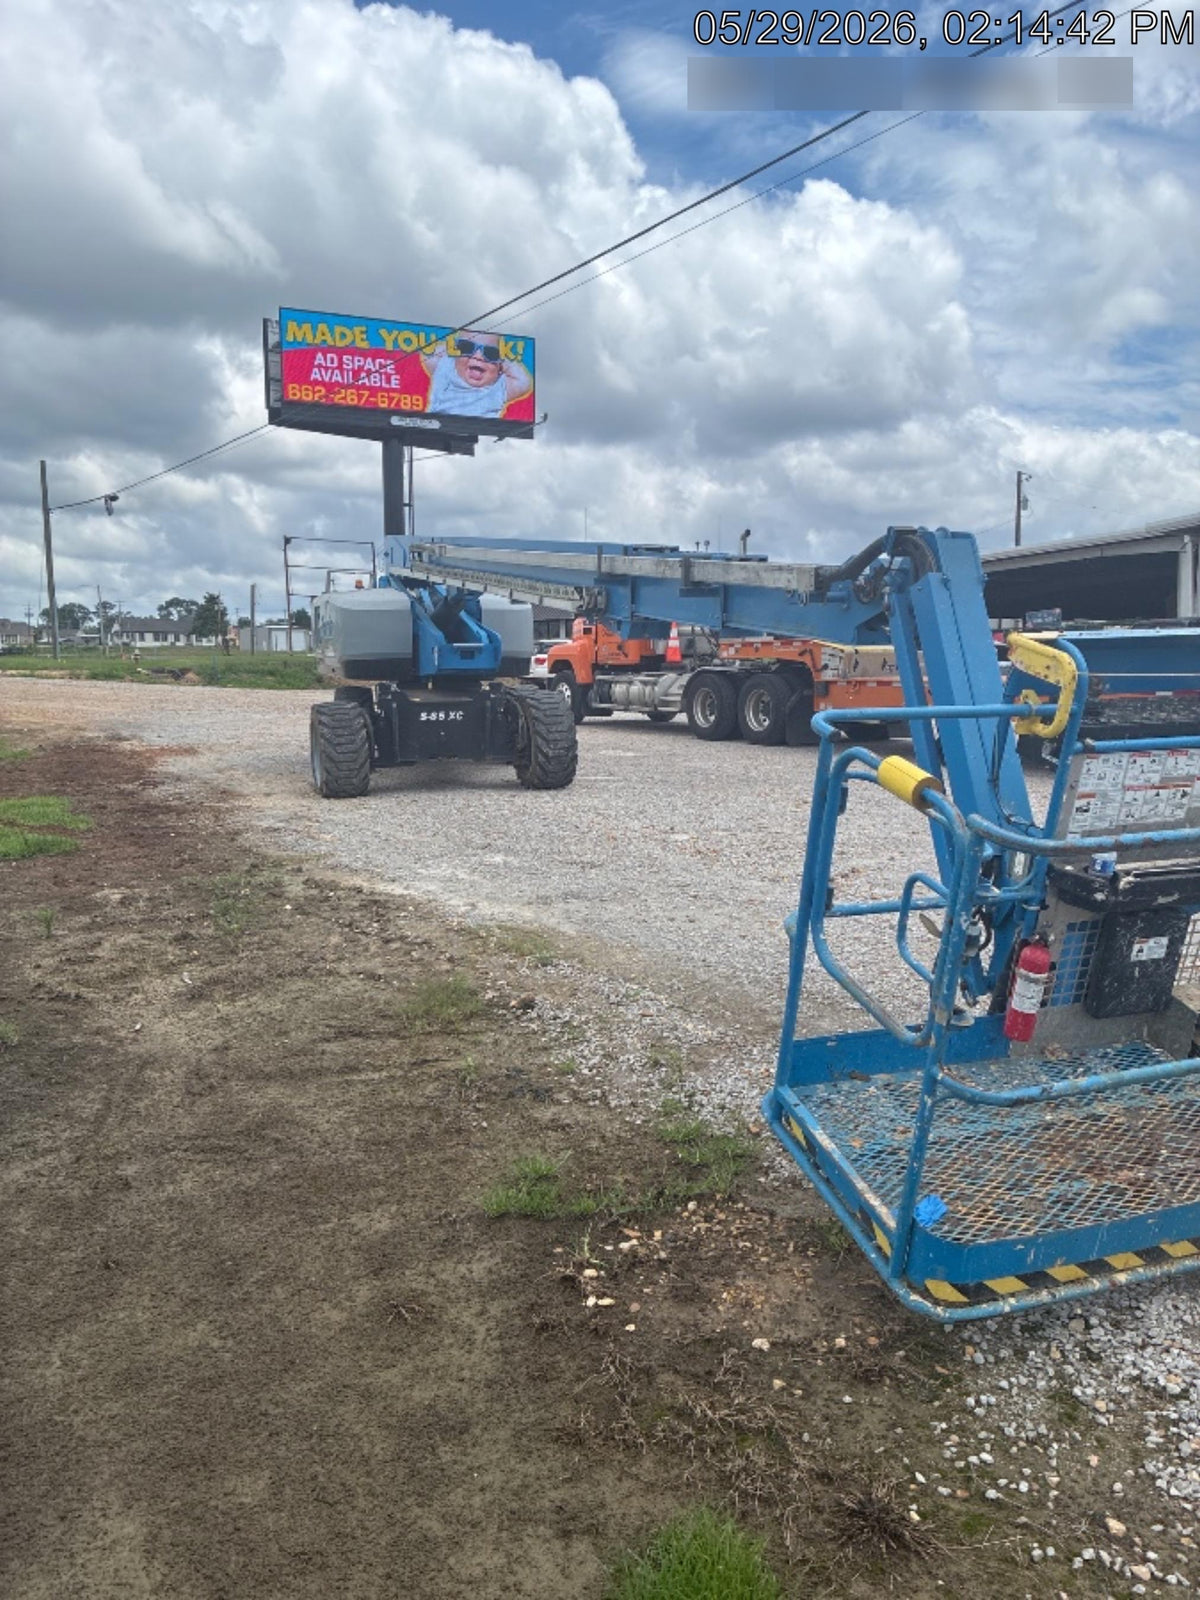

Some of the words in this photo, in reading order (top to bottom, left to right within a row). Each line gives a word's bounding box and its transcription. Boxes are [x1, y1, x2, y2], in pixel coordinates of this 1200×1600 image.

[286, 320, 370, 349] MADE
[378, 328, 437, 355] YOU
[446, 333, 525, 361] LK!
[314, 352, 338, 367] AD
[342, 355, 396, 374] SPACE
[311, 367, 400, 388] AVAILABLE
